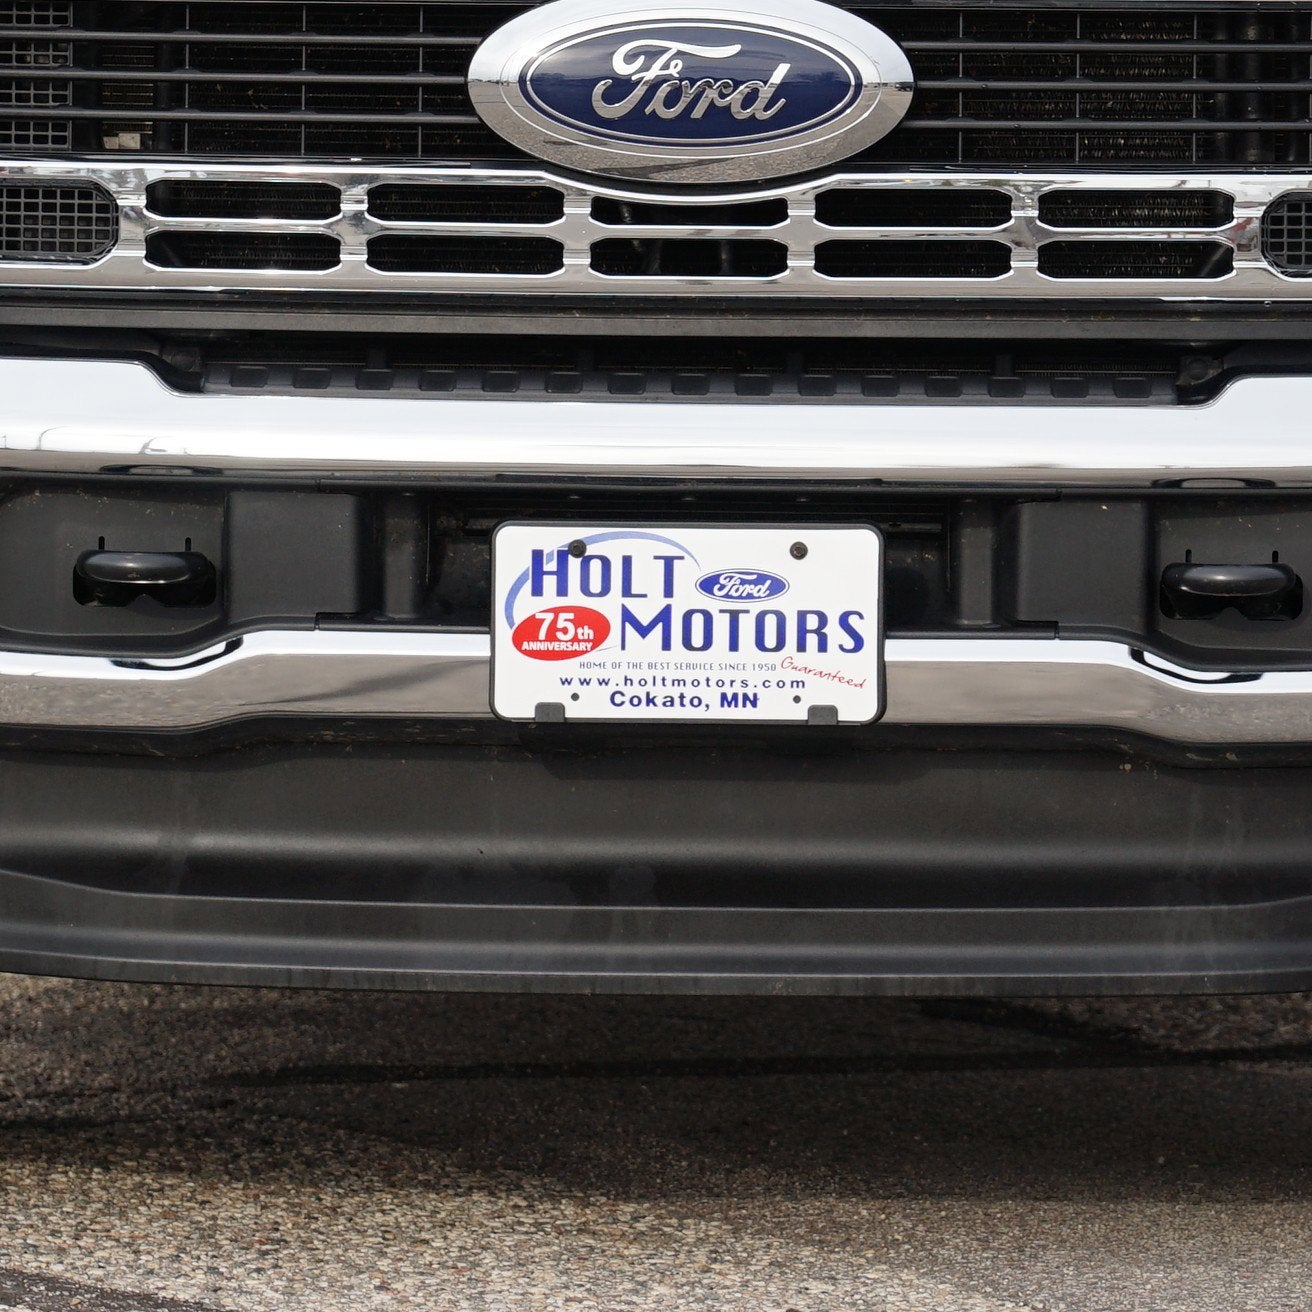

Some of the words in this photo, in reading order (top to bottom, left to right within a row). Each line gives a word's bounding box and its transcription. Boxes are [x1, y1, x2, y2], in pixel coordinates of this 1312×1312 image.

[591, 38, 791, 121] Ford
[530, 548, 685, 599] HOLT
[712, 571, 772, 598] Ford
[535, 612, 594, 641] 75th
[620, 603, 866, 654] MOTORS
[521, 641, 593, 652] ANNIVERSARY
[579, 661, 607, 669] HOME
[611, 661, 623, 670] OF
[626, 661, 642, 670] THE
[647, 661, 671, 670] BEST
[718, 663, 748, 672] SINCE
[752, 663, 777, 672] 1950
[780, 655, 867, 689] Guaranteed
[559, 675, 806, 689] www.holtmotors.com
[609, 690, 710, 712] Cokato,
[720, 691, 758, 708] MN
